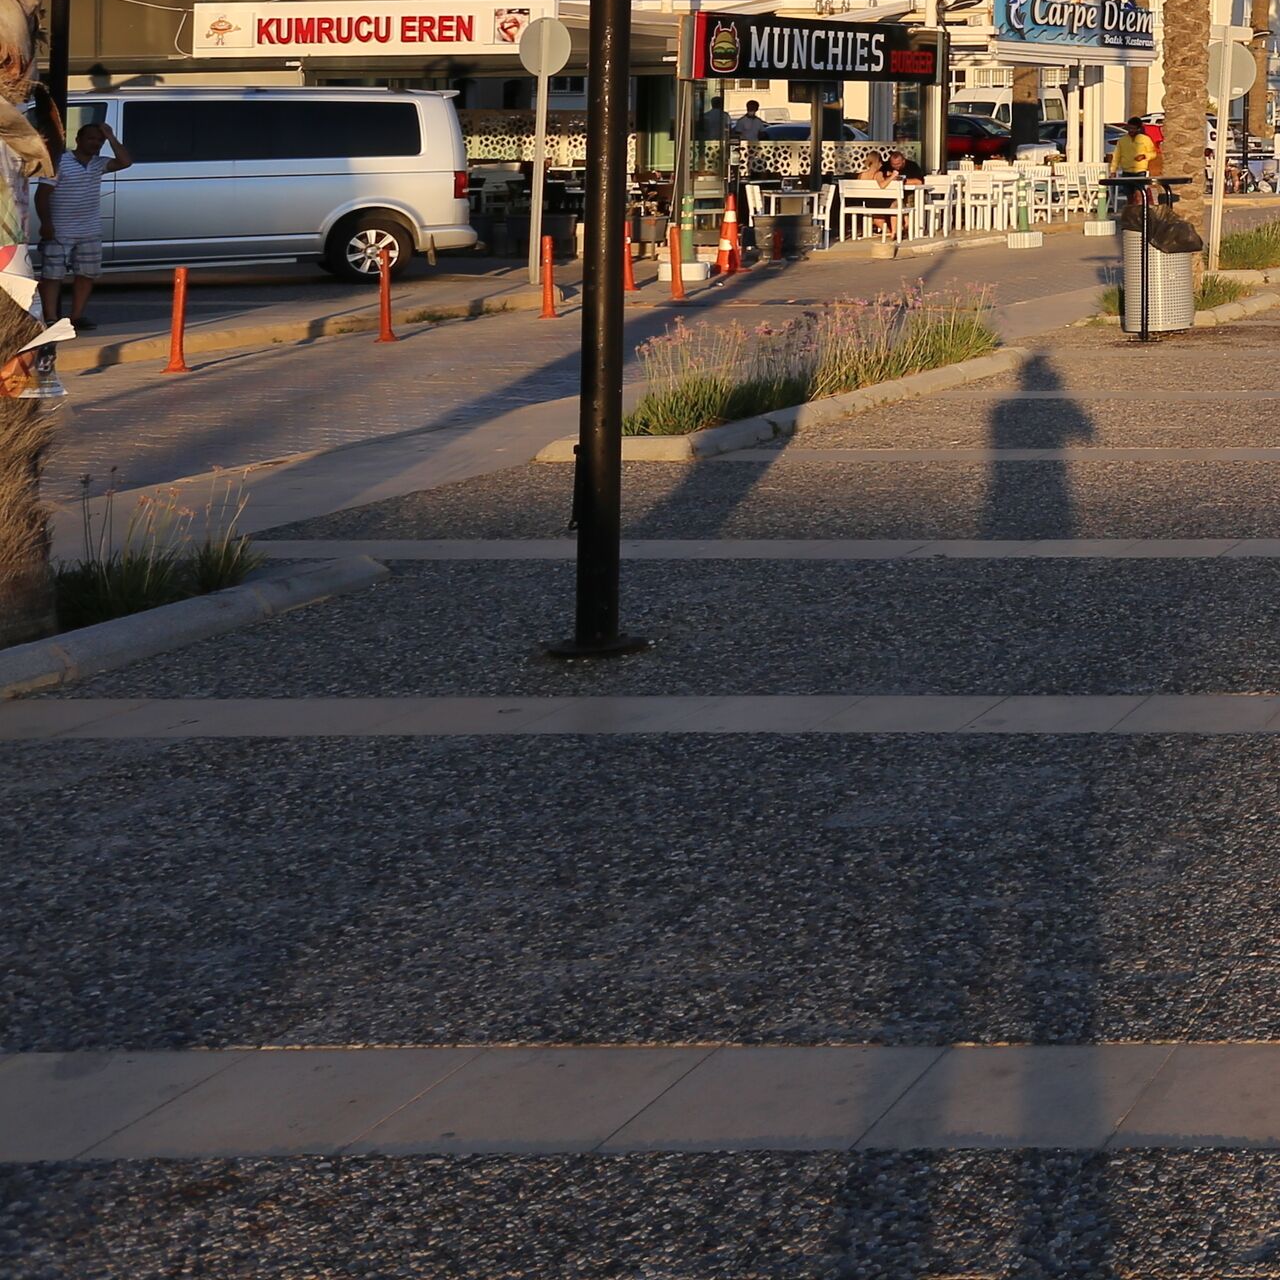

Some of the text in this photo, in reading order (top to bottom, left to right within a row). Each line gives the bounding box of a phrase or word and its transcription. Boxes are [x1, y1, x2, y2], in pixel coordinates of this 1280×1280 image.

[257, 15, 475, 45] KUMRUCU EREN
[1103, 0, 1153, 34] Diem
[749, 26, 934, 74] MUNCHIES BURGER
